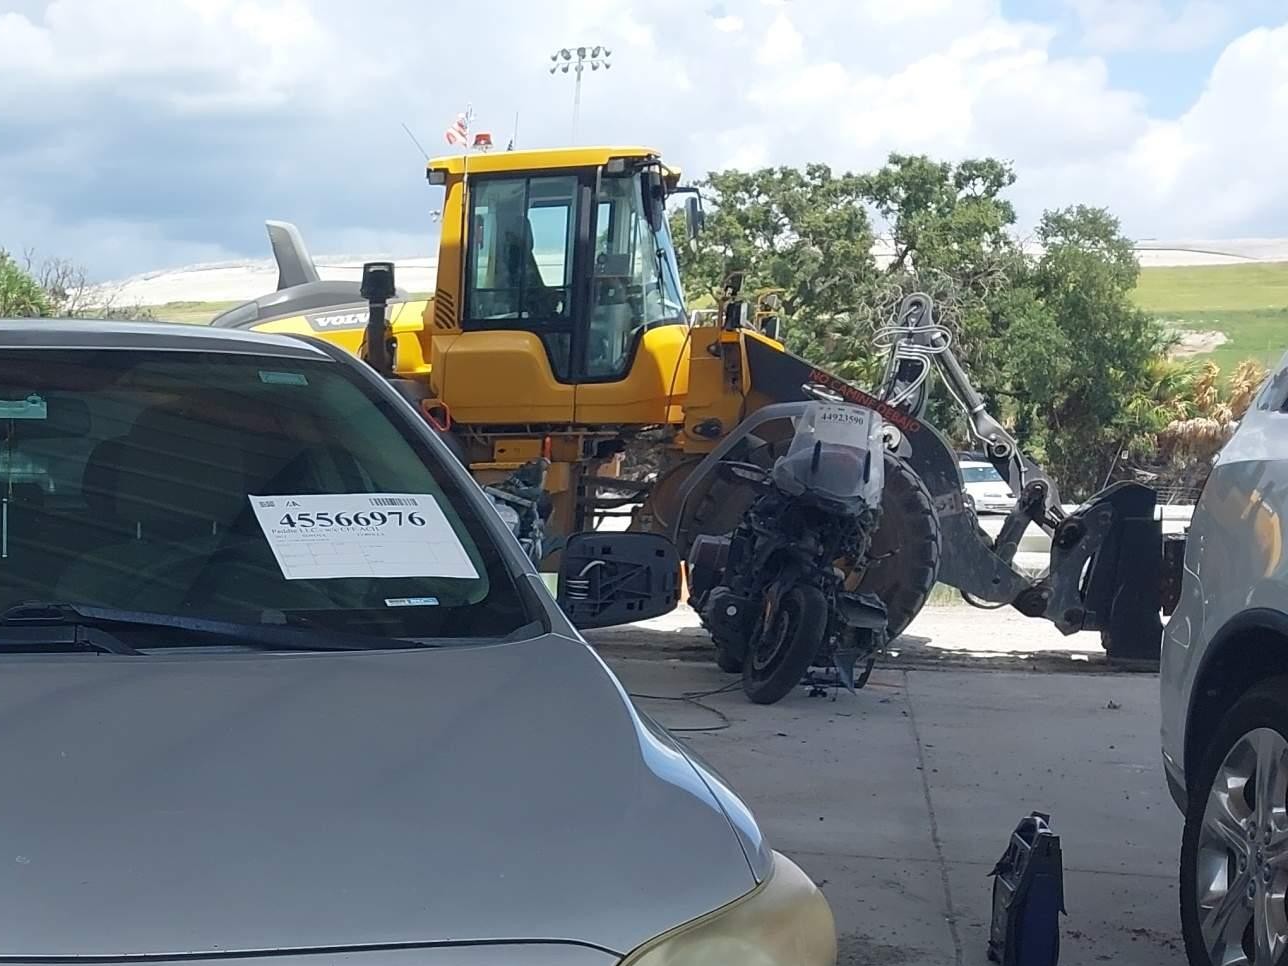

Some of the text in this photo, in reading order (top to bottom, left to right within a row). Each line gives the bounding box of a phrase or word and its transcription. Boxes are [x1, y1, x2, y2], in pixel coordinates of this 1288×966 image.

[314, 312, 370, 327] VOLV
[821, 413, 864, 425] 44923590
[279, 511, 426, 528] 45566976
